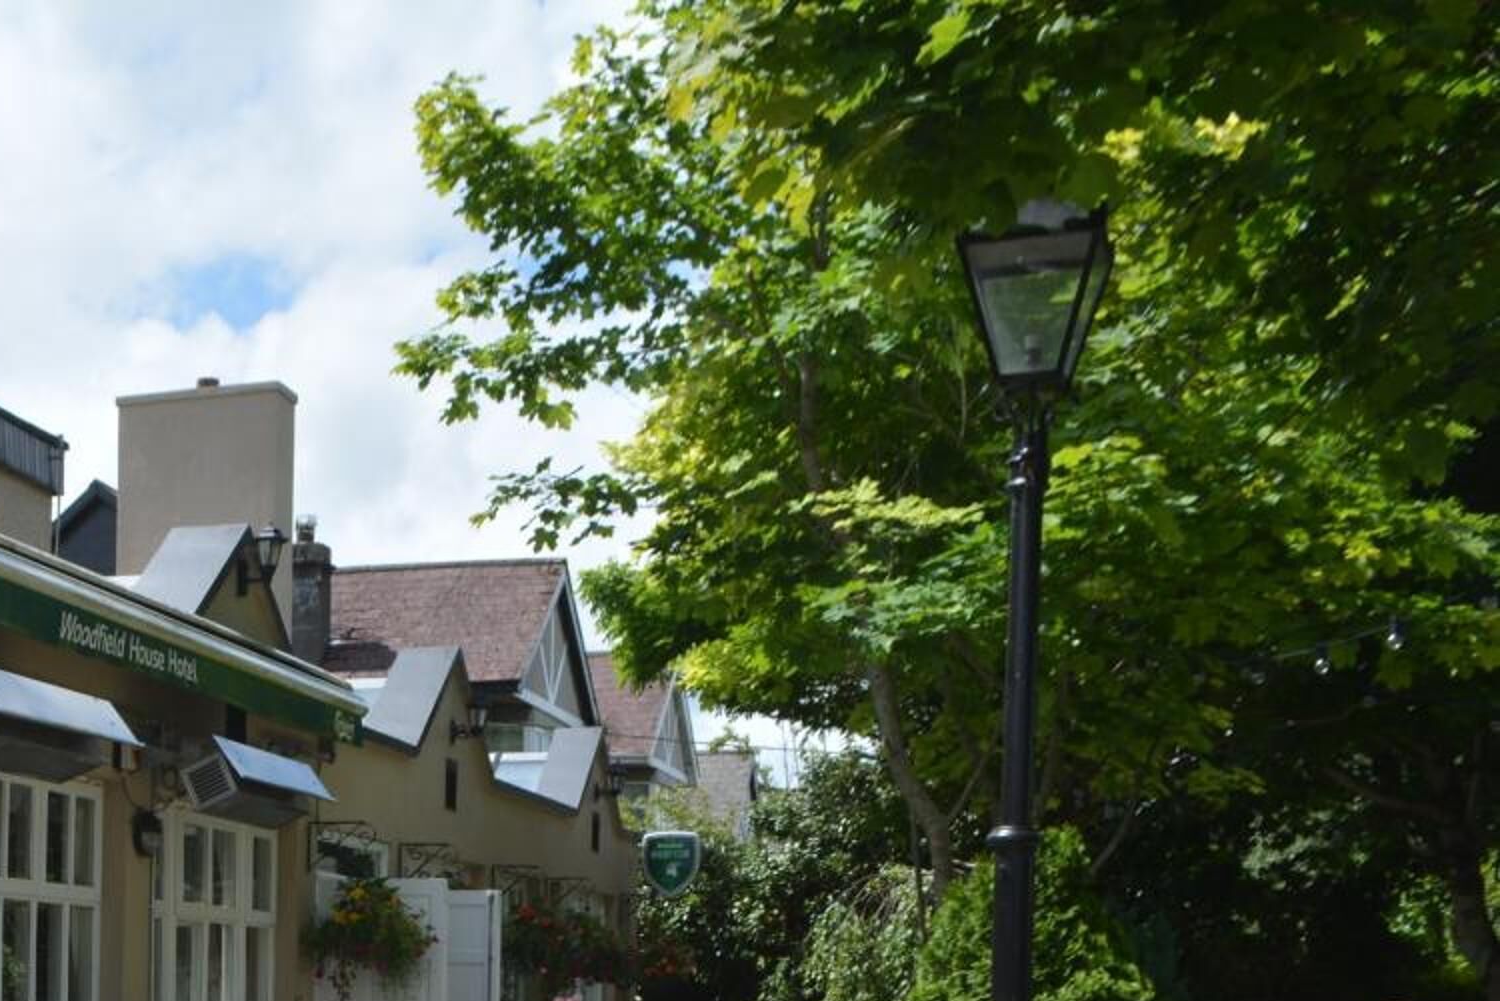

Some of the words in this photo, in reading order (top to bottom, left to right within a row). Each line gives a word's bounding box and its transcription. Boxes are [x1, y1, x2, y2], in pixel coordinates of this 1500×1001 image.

[59, 609, 127, 658] Woodfield
[128, 633, 166, 671] House
[167, 646, 198, 684] Hotel
